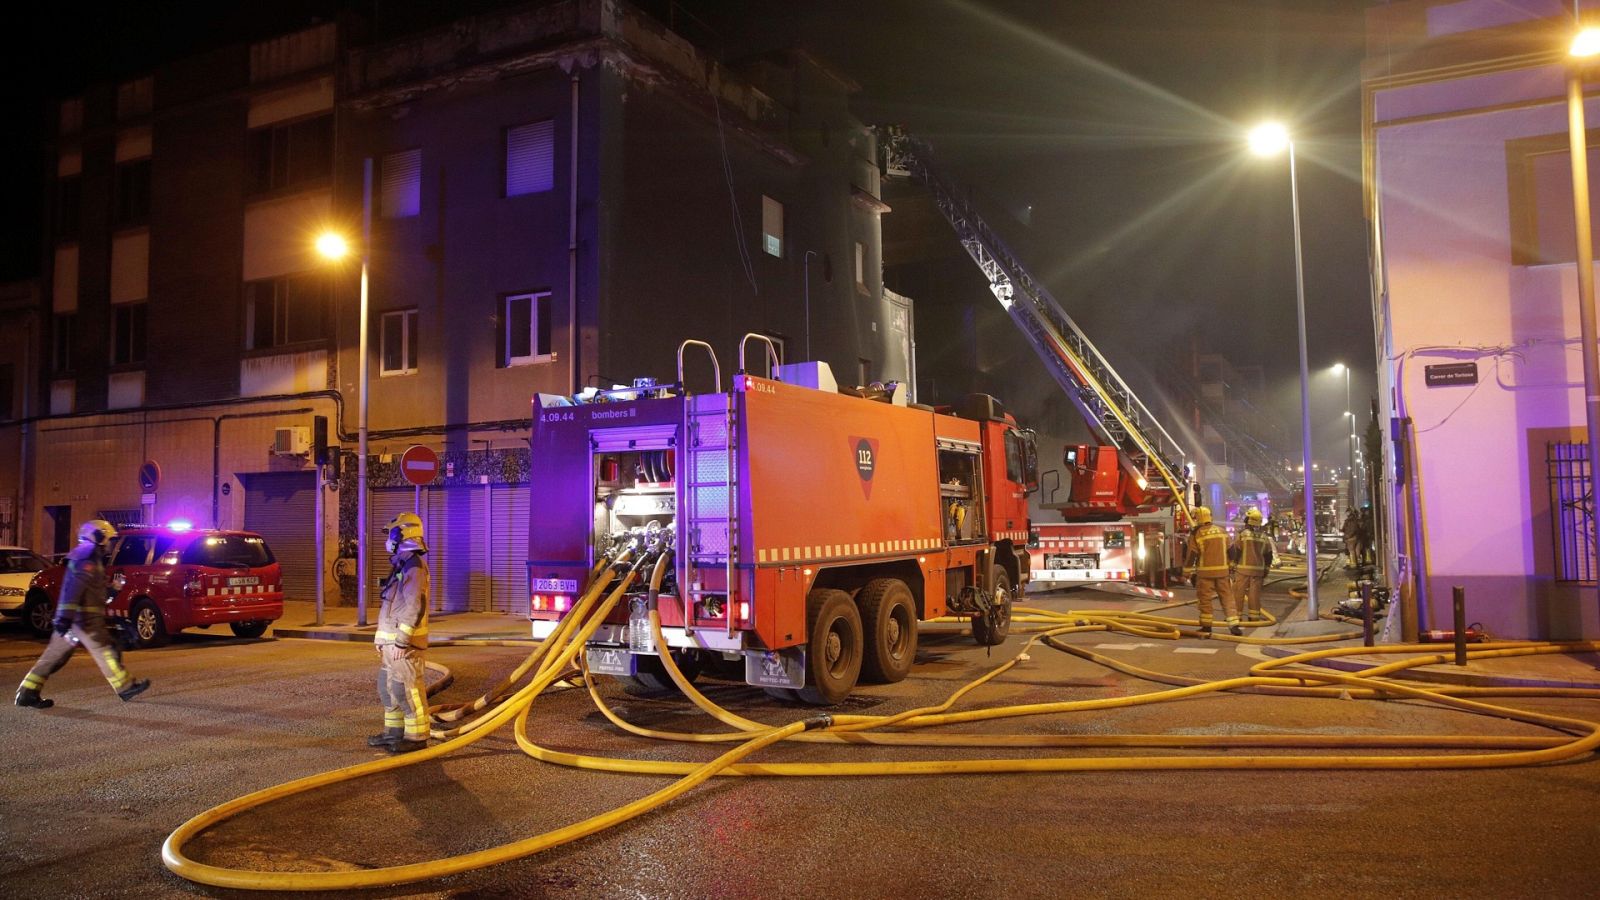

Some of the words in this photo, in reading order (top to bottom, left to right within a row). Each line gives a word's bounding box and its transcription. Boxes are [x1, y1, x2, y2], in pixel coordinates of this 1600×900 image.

[540, 412, 575, 423] 4.09.44
[591, 409, 629, 420] bombers
[858, 449, 872, 465] 112
[538, 580, 558, 590] 2063
[560, 580, 576, 591] BVH
